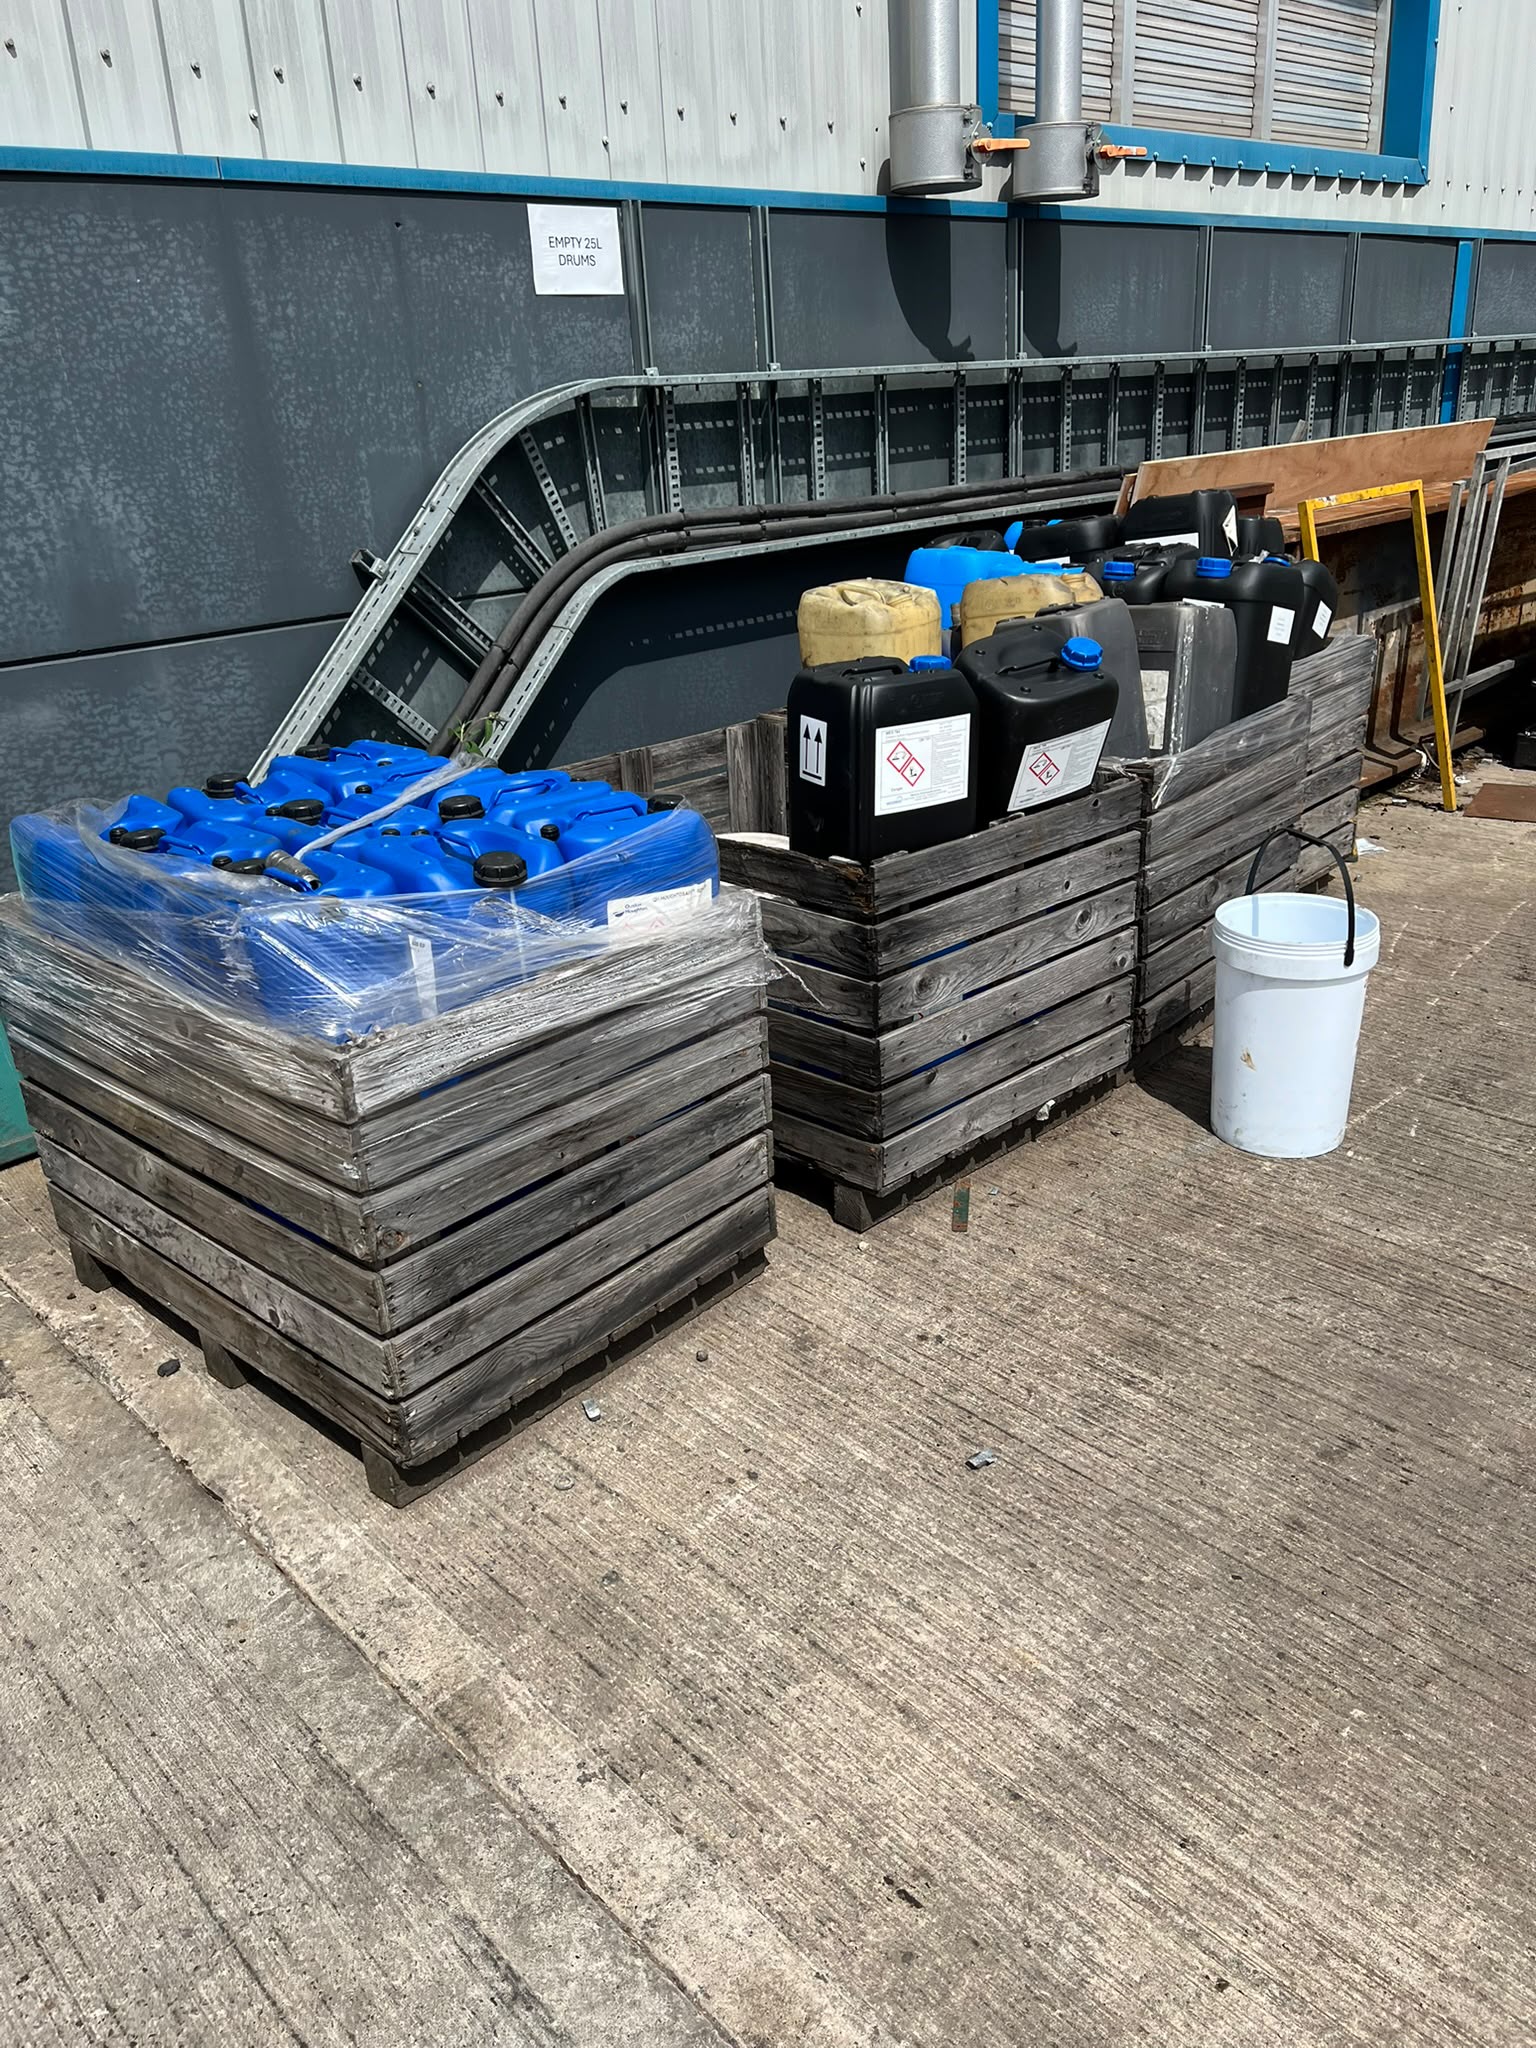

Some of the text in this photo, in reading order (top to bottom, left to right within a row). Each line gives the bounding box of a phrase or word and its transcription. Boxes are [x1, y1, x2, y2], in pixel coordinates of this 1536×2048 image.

[548, 236, 602, 249] EMPTY 25L
[558, 254, 596, 266] DRUMS
